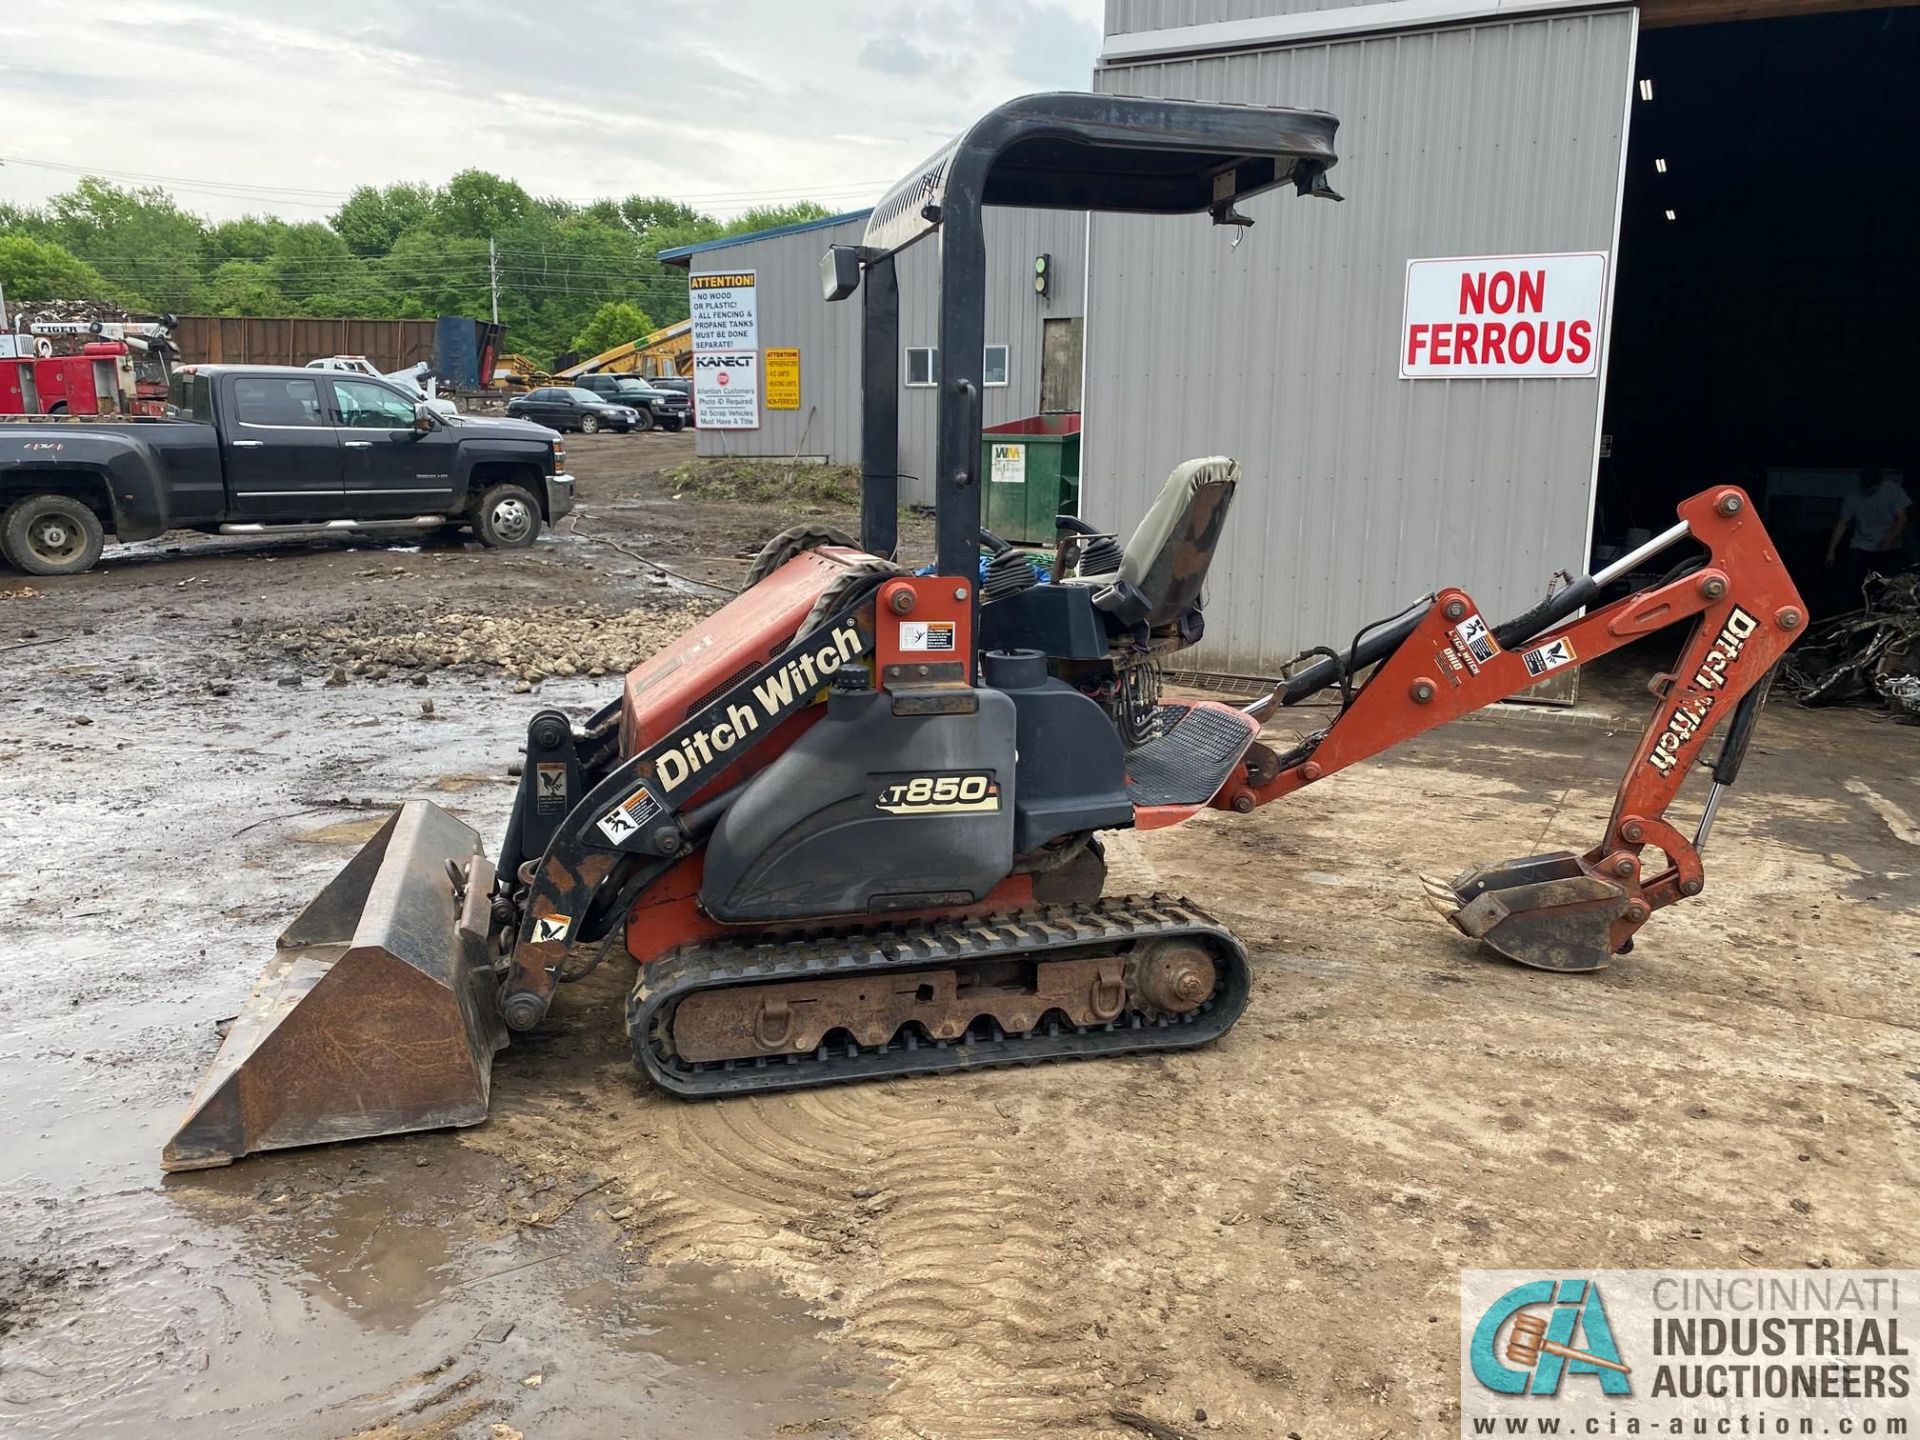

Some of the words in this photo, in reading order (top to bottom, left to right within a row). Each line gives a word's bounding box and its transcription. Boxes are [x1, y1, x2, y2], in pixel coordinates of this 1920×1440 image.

[691, 275, 754, 288] ATTENTION!
[709, 292, 732, 300] WOOD
[1459, 270, 1546, 315] NON
[705, 301, 737, 309] PLASTIC!
[713, 311, 745, 319] FENCING
[694, 321, 727, 329] PROPANE
[729, 320, 754, 328] TANKS
[695, 331, 714, 339] MUST
[728, 330, 748, 338] DONE
[695, 341, 734, 349] SEPARATE!
[1408, 320, 1592, 365] FERROUS
[696, 356, 754, 368] KANECT
[726, 398, 753, 406] Required
[728, 409, 754, 417] Vehicles
[1694, 606, 1758, 690] Ditch
[1442, 646, 1463, 671] OHIO
[655, 703, 759, 793] Ditch
[752, 627, 863, 716] Witch
